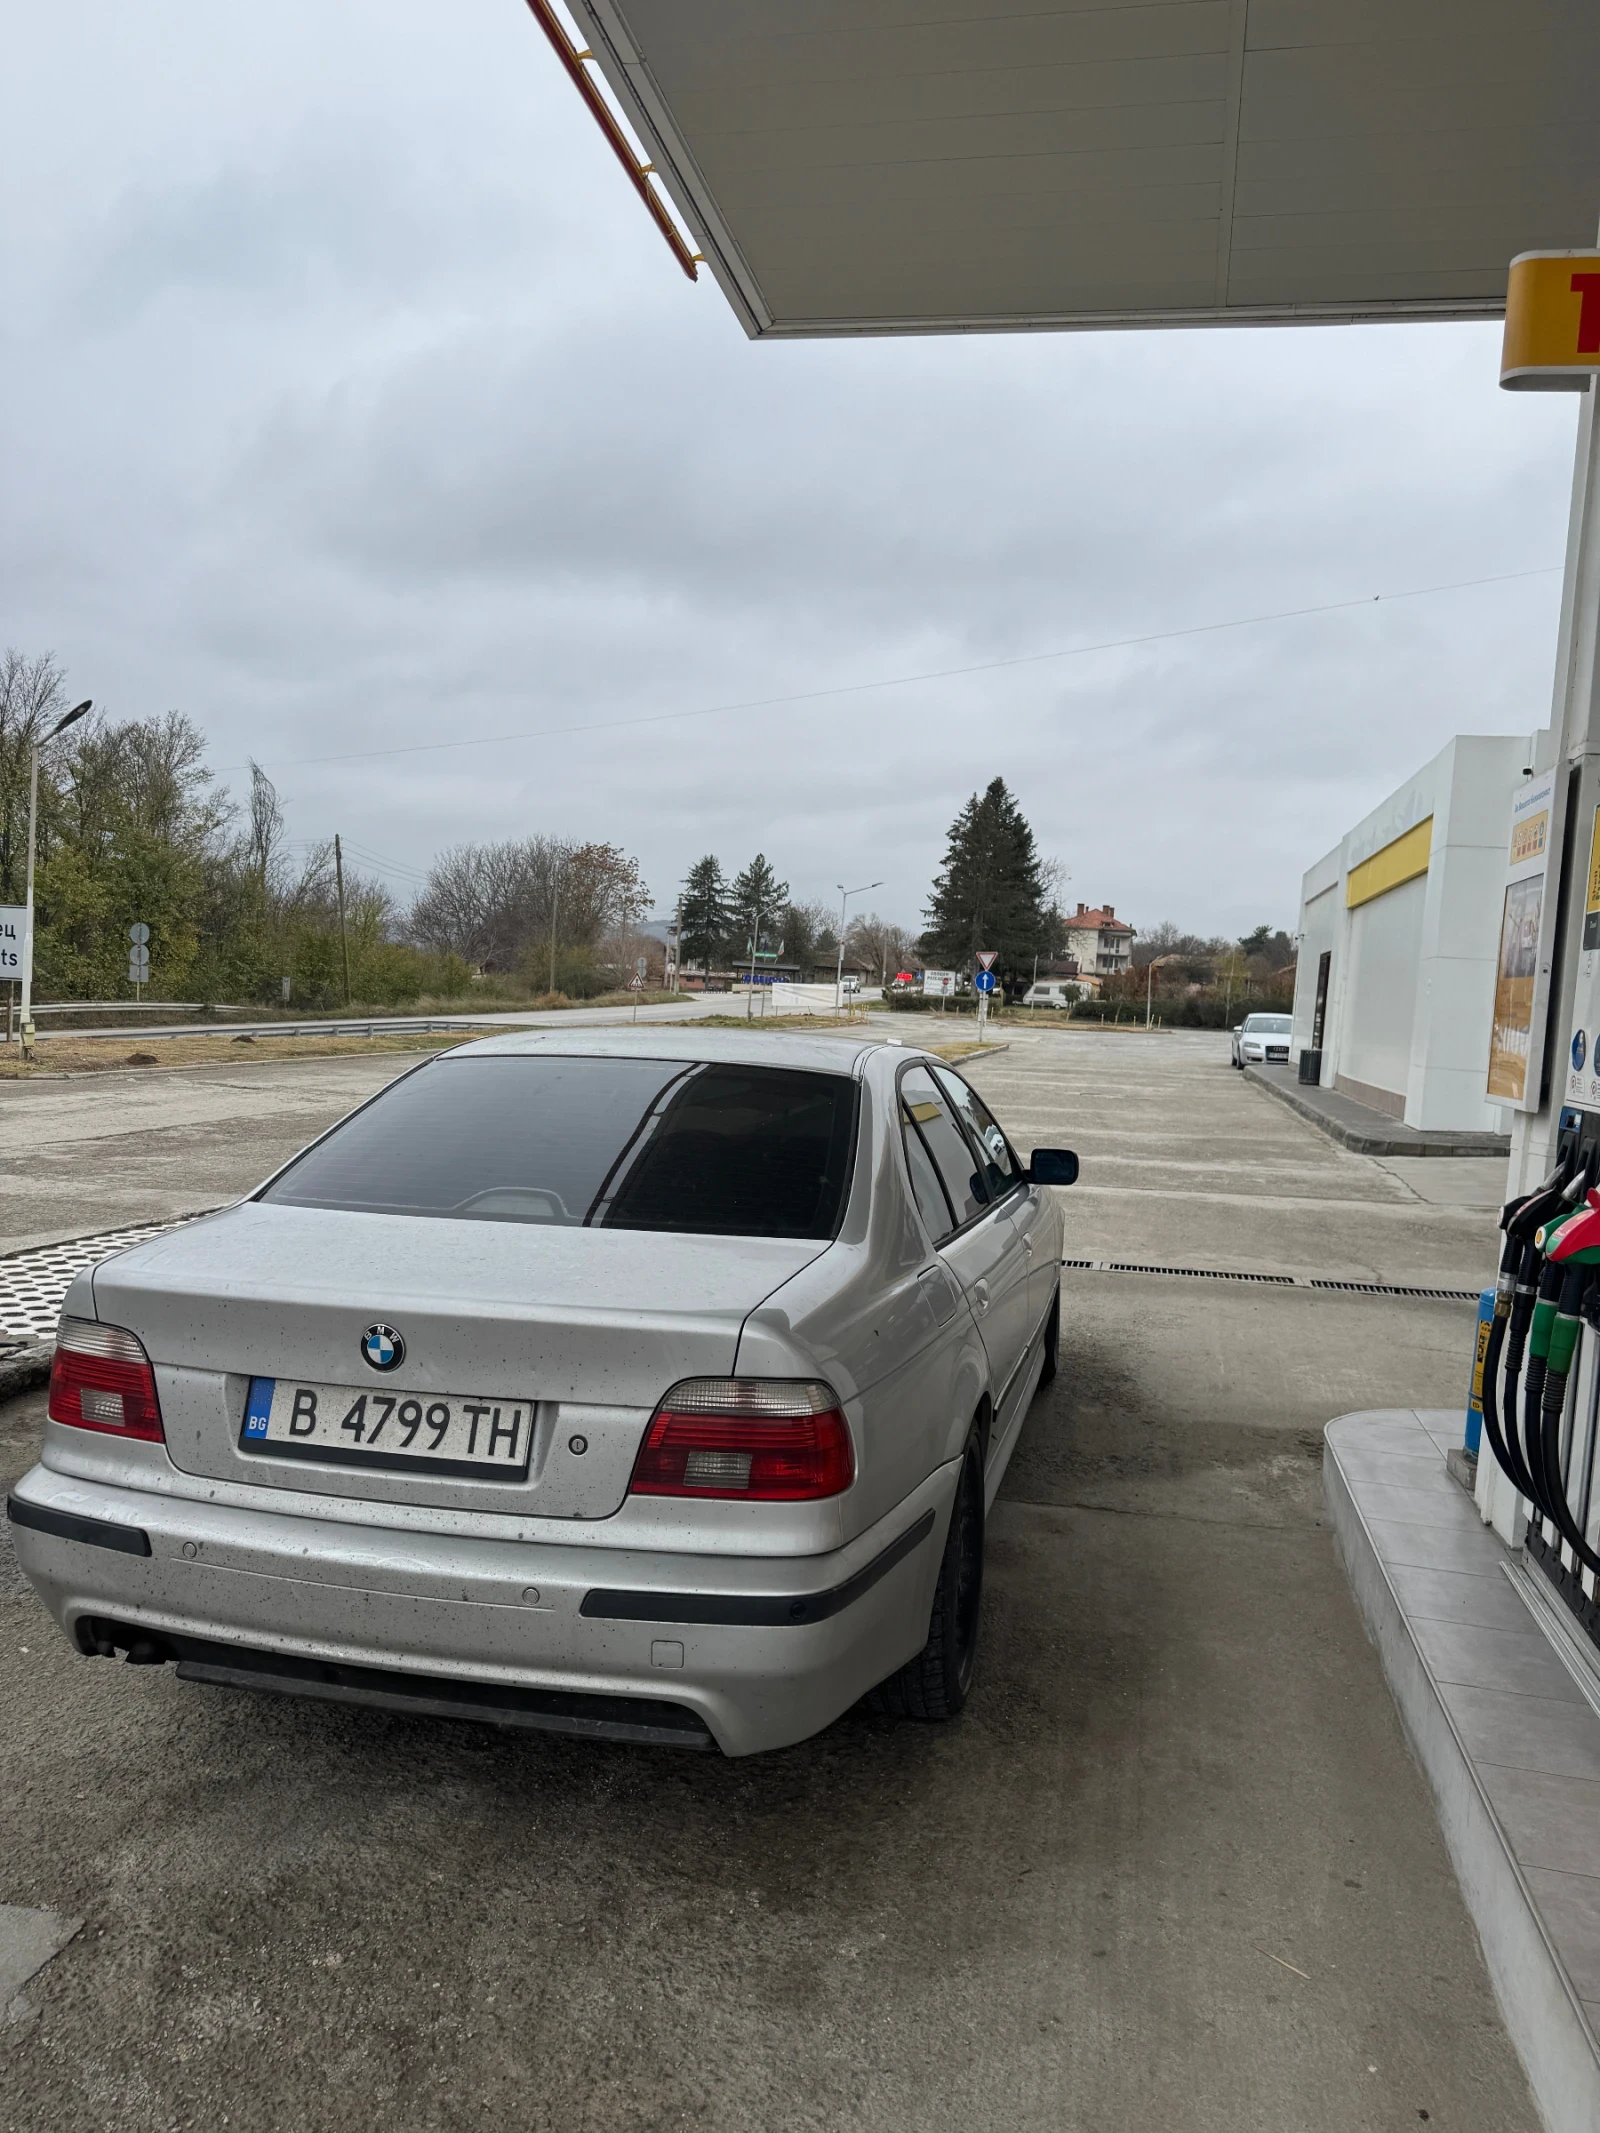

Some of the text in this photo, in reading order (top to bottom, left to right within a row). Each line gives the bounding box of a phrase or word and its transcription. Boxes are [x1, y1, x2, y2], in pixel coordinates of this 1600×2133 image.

[364, 1325, 400, 1343] BMW
[248, 1415, 267, 1432] BG
[288, 1388, 522, 1459] B 4799 TH
